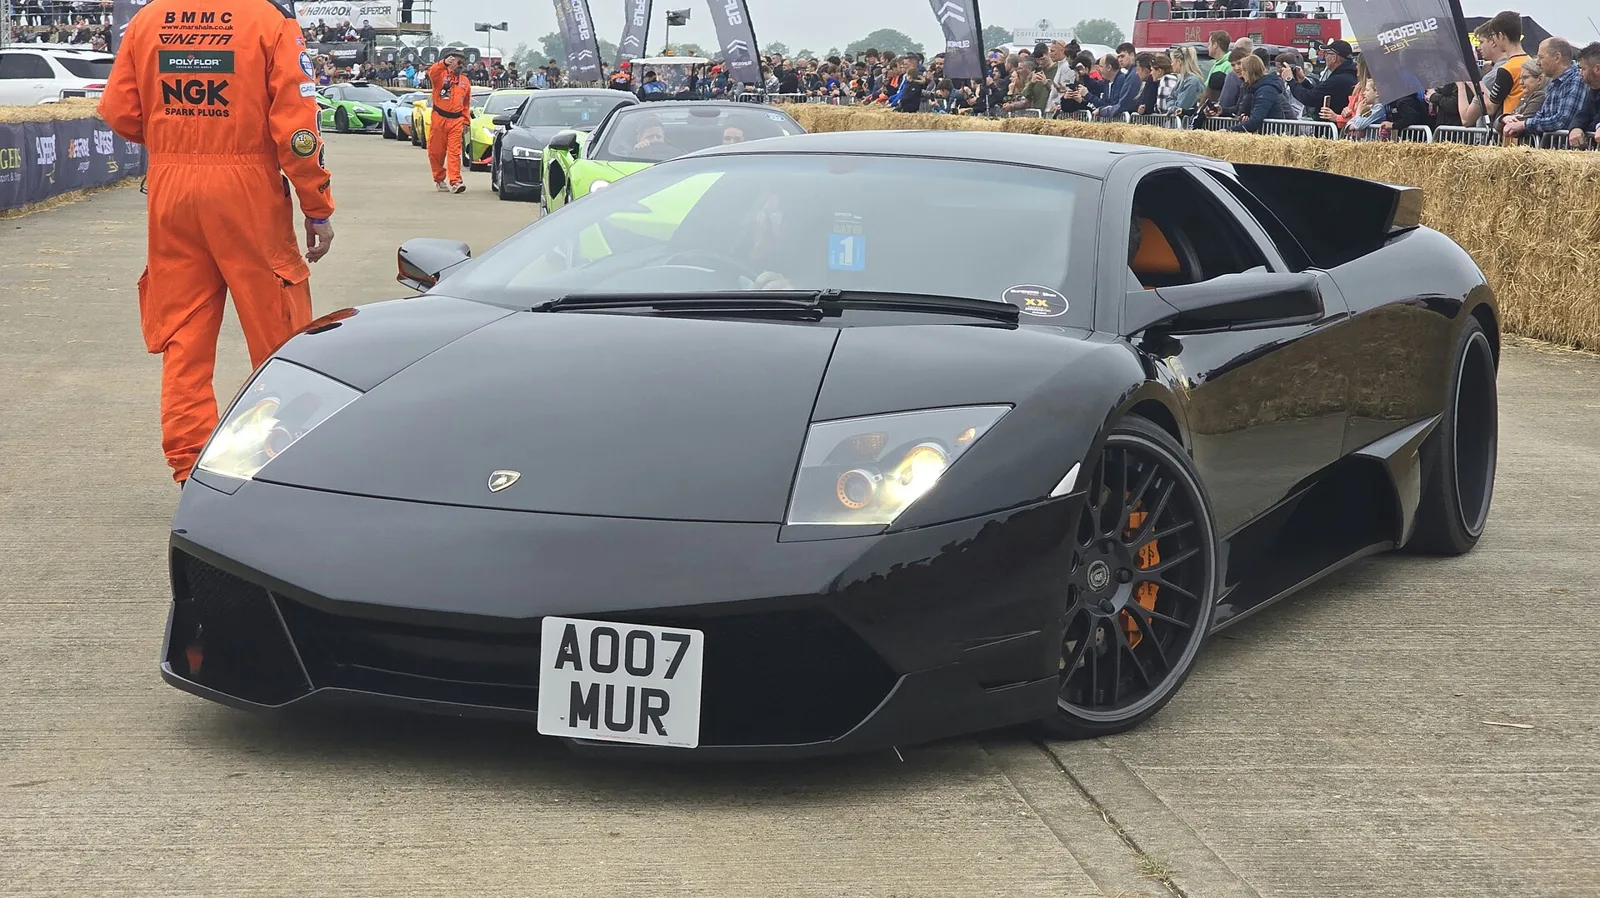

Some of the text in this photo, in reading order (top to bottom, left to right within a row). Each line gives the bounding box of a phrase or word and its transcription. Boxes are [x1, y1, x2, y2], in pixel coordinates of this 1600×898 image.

[360, 6, 391, 15] SUPERCAR
[158, 33, 234, 45] GINETTA
[1184, 26, 1202, 41] BAR
[169, 58, 220, 66] POLYFLOR
[161, 78, 229, 107] NGK
[165, 107, 229, 117] SPARK PLUGS
[1024, 298, 1049, 307] XX
[569, 680, 670, 737] MUR
